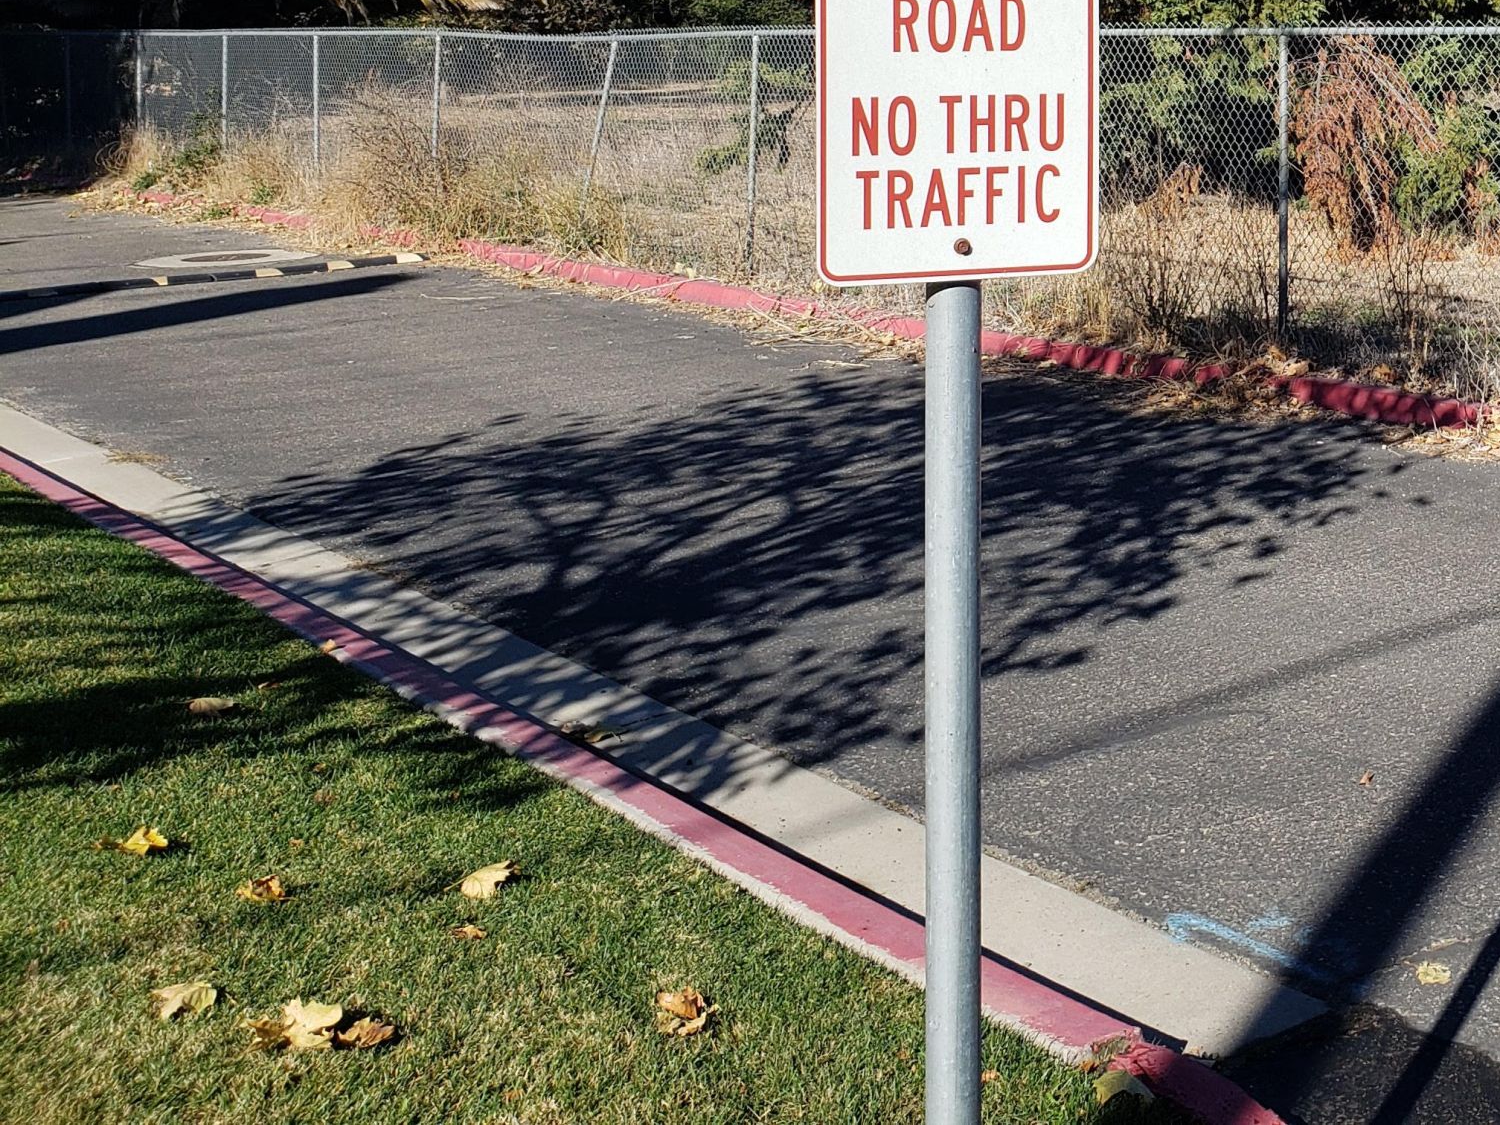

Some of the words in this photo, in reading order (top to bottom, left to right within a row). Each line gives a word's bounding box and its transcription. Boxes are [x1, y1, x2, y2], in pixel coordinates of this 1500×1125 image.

[851, 95, 917, 156] NO
[939, 93, 1064, 153] THRU
[856, 164, 1061, 229] TRAFFIC
